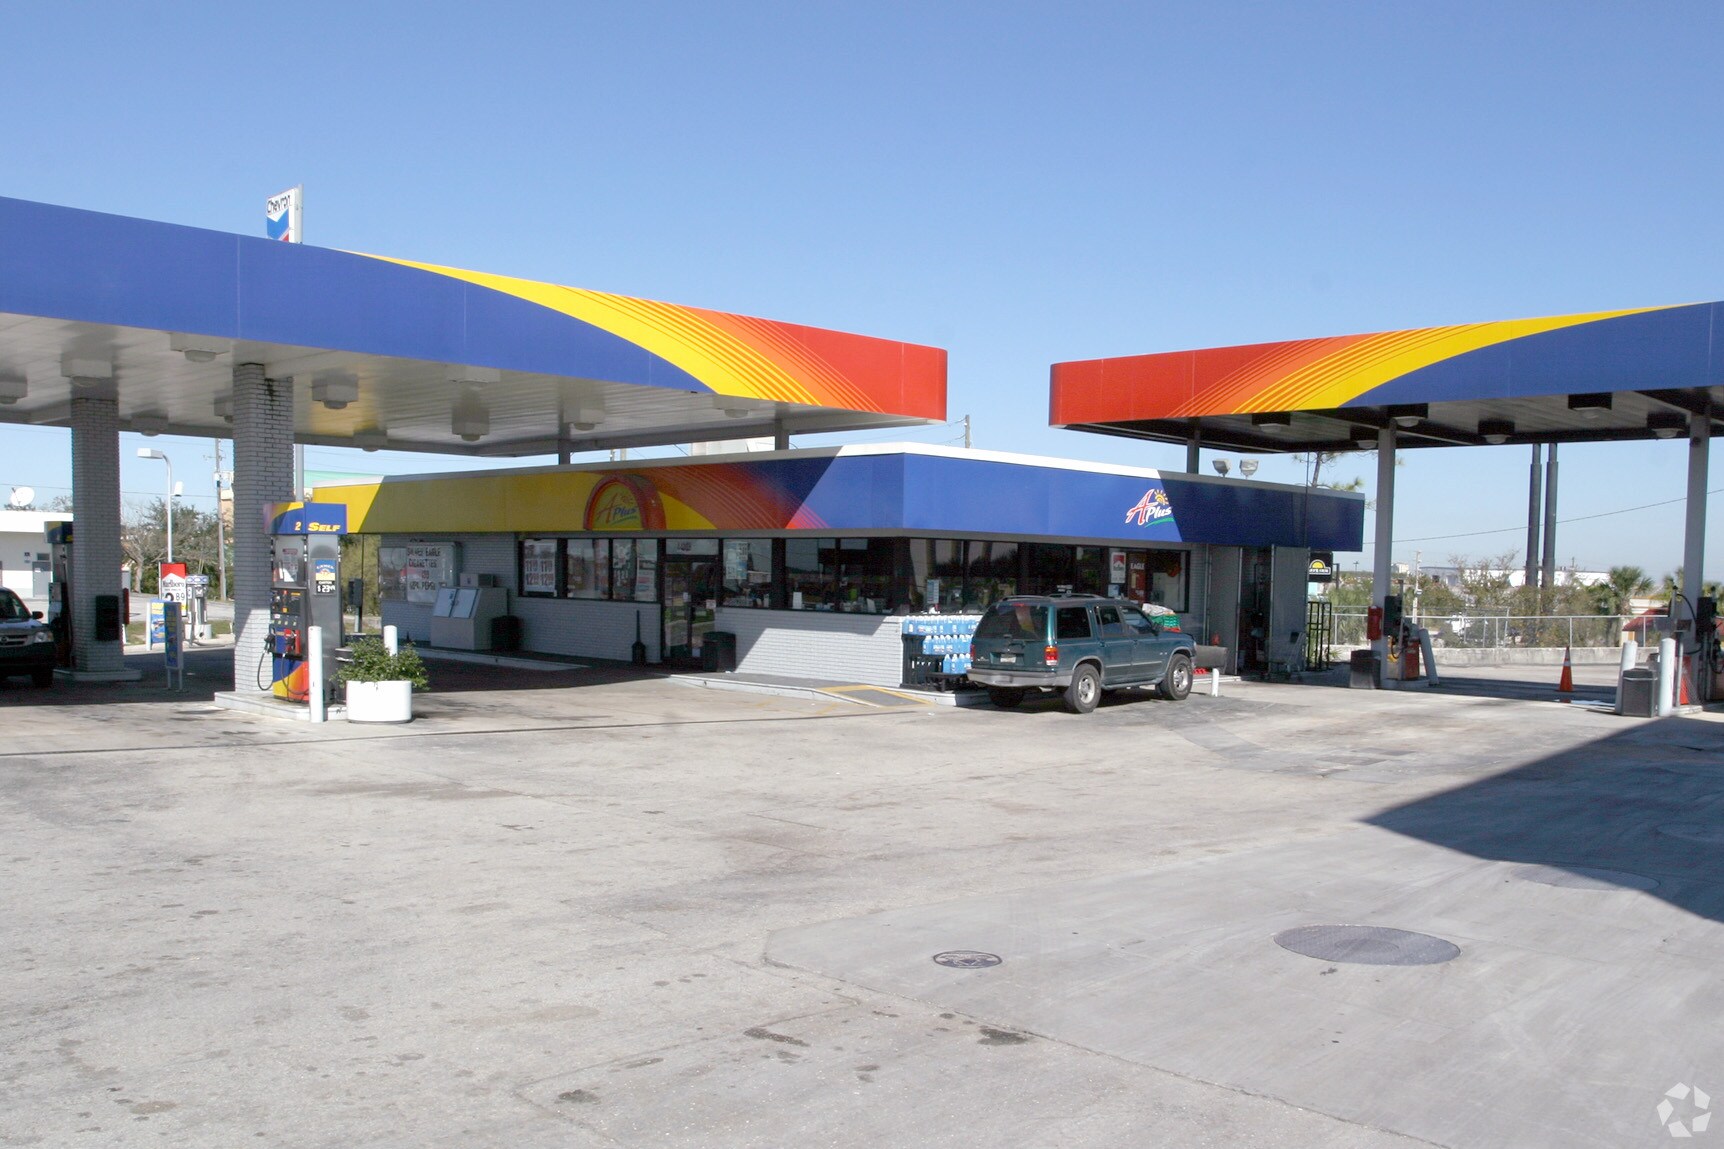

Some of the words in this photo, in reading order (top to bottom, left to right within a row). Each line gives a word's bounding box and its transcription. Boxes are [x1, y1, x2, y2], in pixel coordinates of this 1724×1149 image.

[267, 195, 290, 213] Chevron
[294, 521, 302, 531] 2
[307, 521, 341, 531] SELF
[1130, 562, 1145, 570] EAGLE
[163, 579, 185, 588] Marlboro
